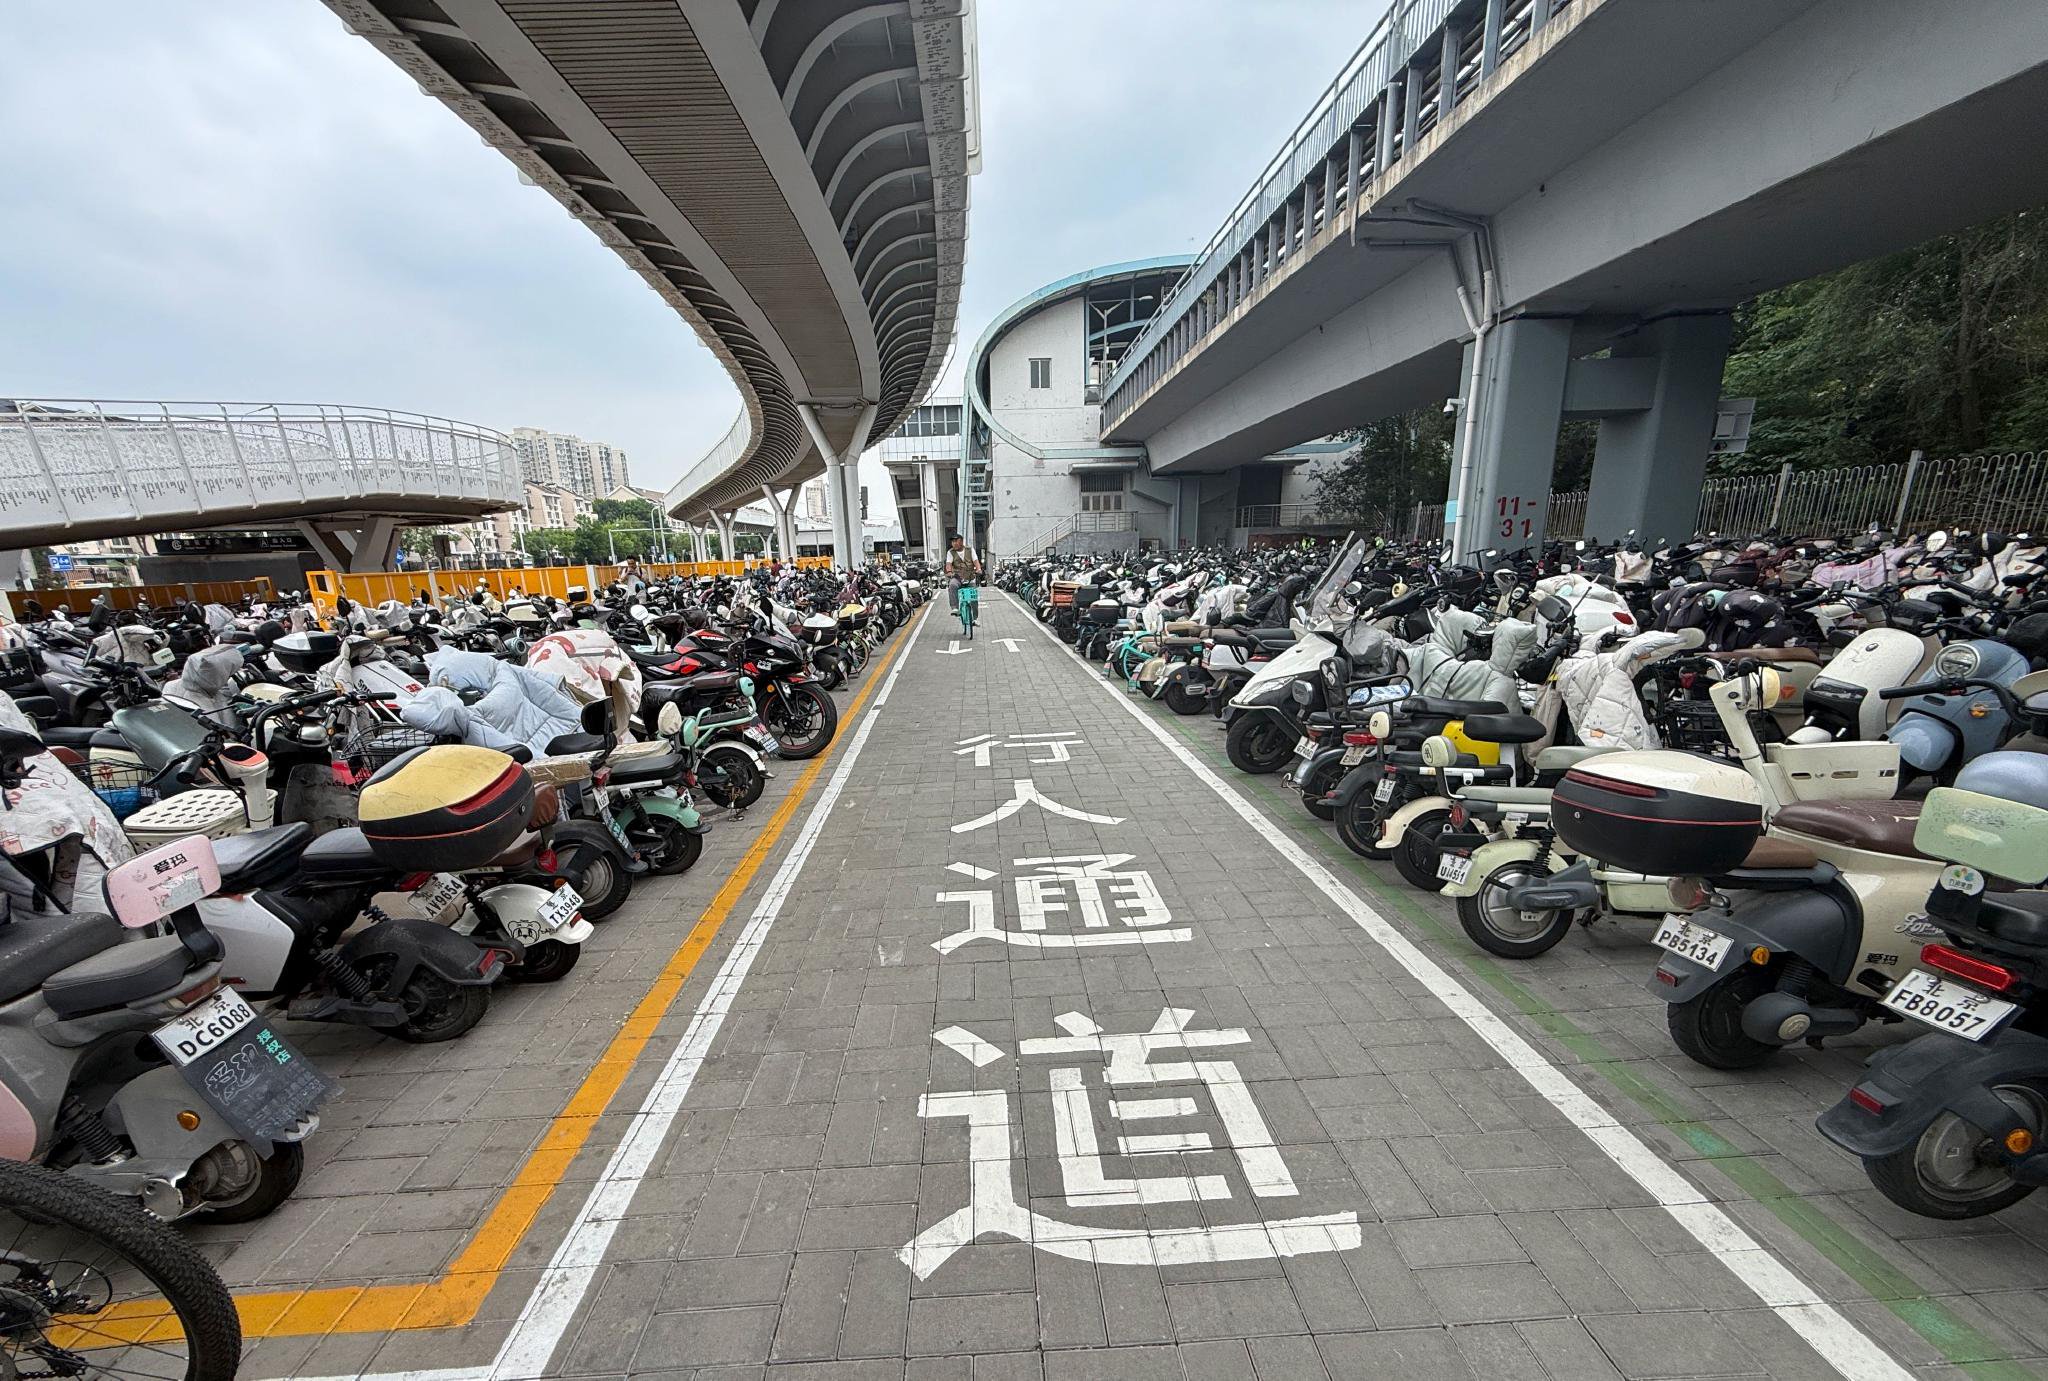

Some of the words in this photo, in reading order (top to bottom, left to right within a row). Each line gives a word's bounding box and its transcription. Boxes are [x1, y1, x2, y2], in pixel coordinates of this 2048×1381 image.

[550, 894, 582, 925] TX3948
[1658, 930, 1718, 966] PB5134
[897, 731, 1362, 1281] 行人通道
[1891, 989, 1986, 1033] FB8057
[1922, 979, 1985, 1011] 北京
[177, 1003, 251, 1057] DC6088
[183, 996, 231, 1031] 北京
[256, 1028, 292, 1065] 授权店
